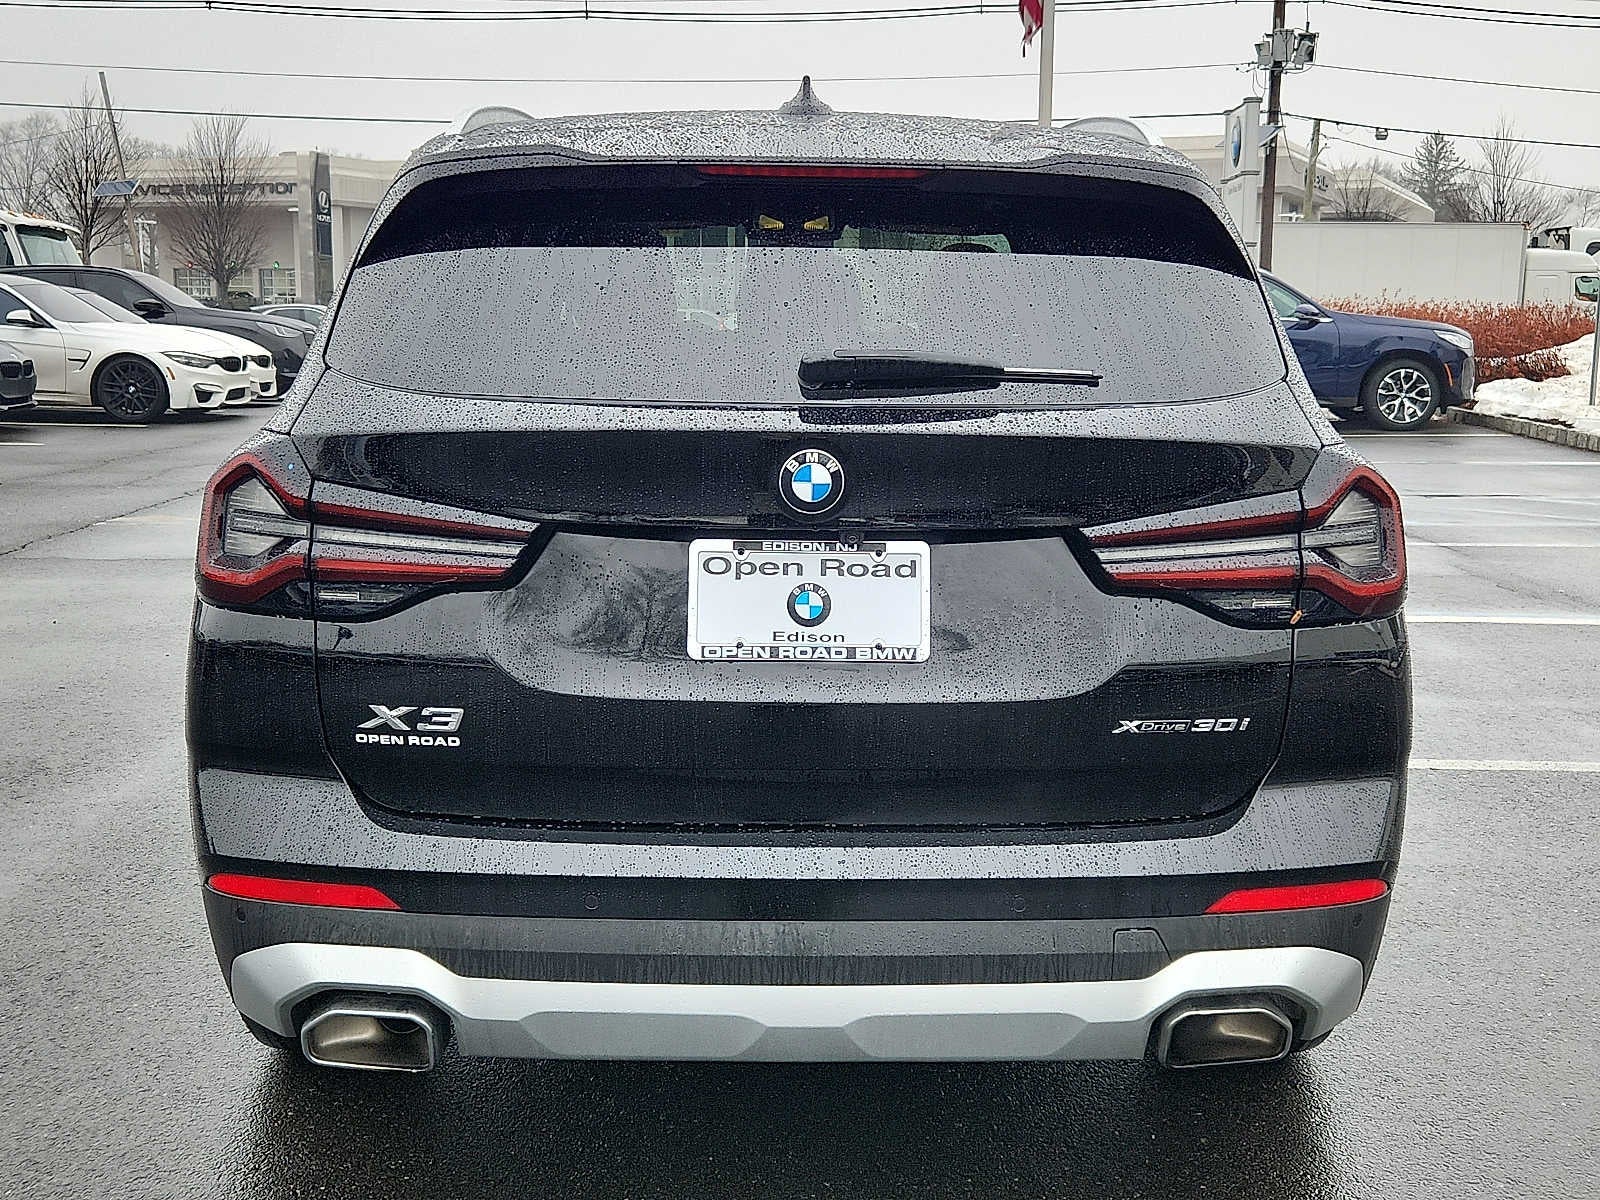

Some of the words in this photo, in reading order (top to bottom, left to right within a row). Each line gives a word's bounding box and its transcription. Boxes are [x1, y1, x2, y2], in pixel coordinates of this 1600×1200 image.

[786, 452, 840, 473] BMW
[762, 541, 830, 552] EDISON,
[836, 543, 858, 552] NJ
[702, 556, 804, 580] Open
[820, 558, 918, 578] Road
[793, 583, 828, 597] BMW
[772, 631, 845, 643] Edison
[703, 646, 771, 659] OPEN
[778, 646, 848, 659] ROAD
[855, 647, 916, 660] BMW
[356, 704, 464, 732] X3
[355, 733, 404, 745] OPEN
[407, 735, 461, 747] ROAD
